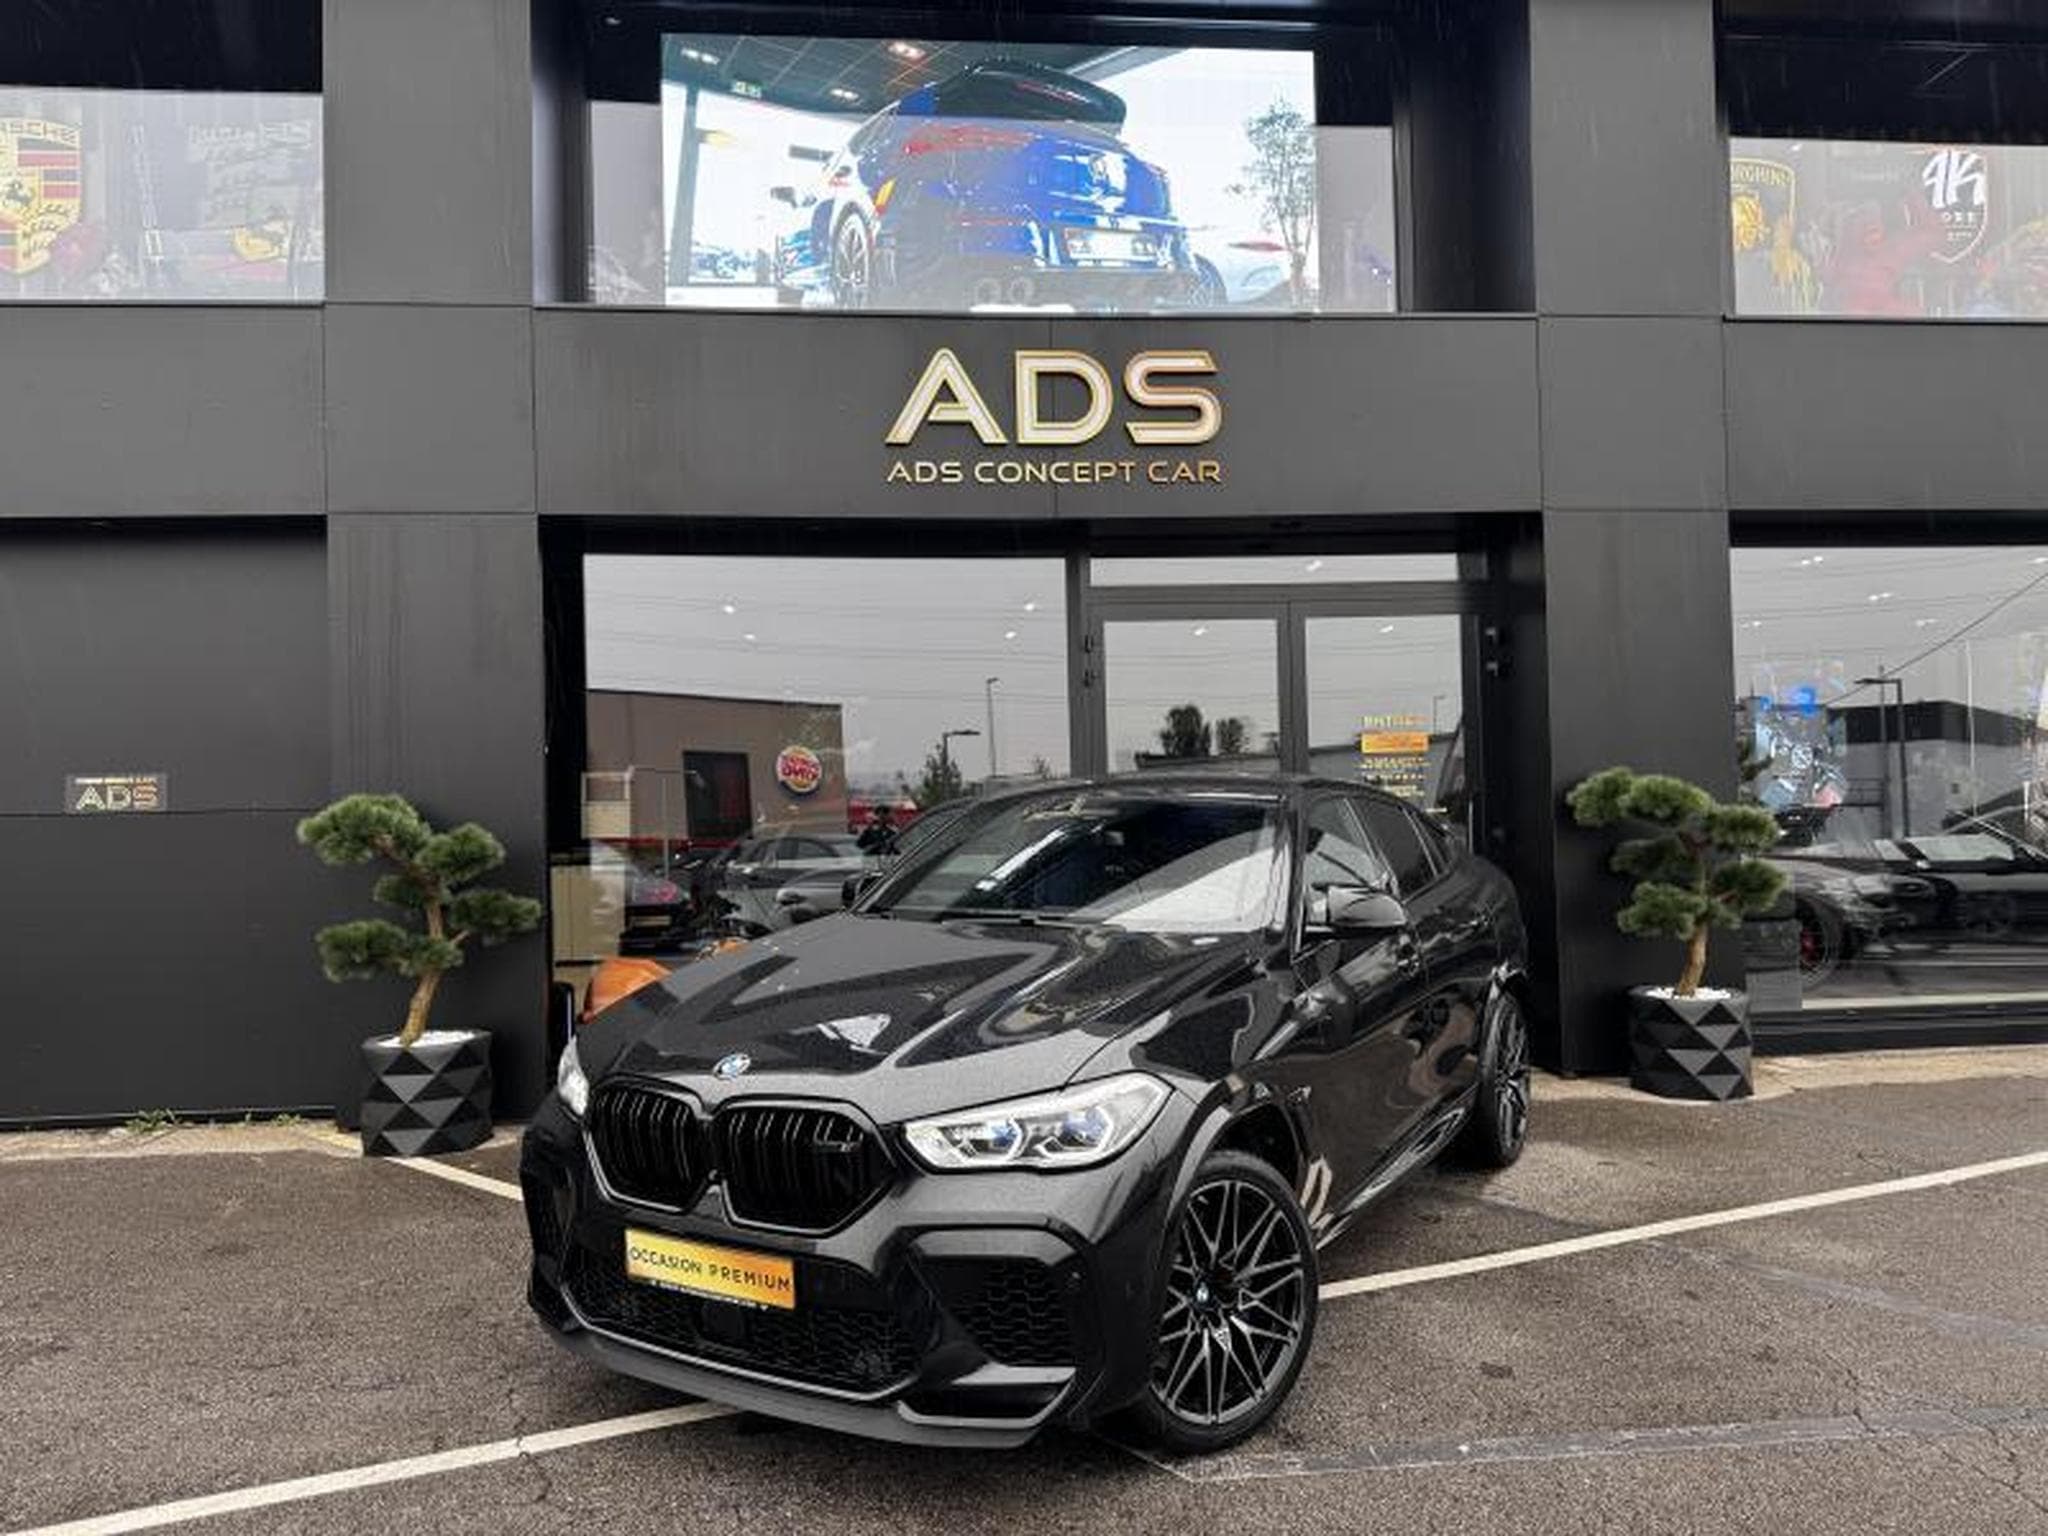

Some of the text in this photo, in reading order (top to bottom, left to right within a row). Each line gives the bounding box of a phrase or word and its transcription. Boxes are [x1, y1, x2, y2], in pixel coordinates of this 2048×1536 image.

[884, 347, 1223, 445] ADS
[887, 461, 1222, 484] ADS CONCEPT CAR
[75, 784, 159, 811] ADS
[629, 1245, 703, 1274] OCCASION
[708, 1263, 792, 1292] PREMIUM
